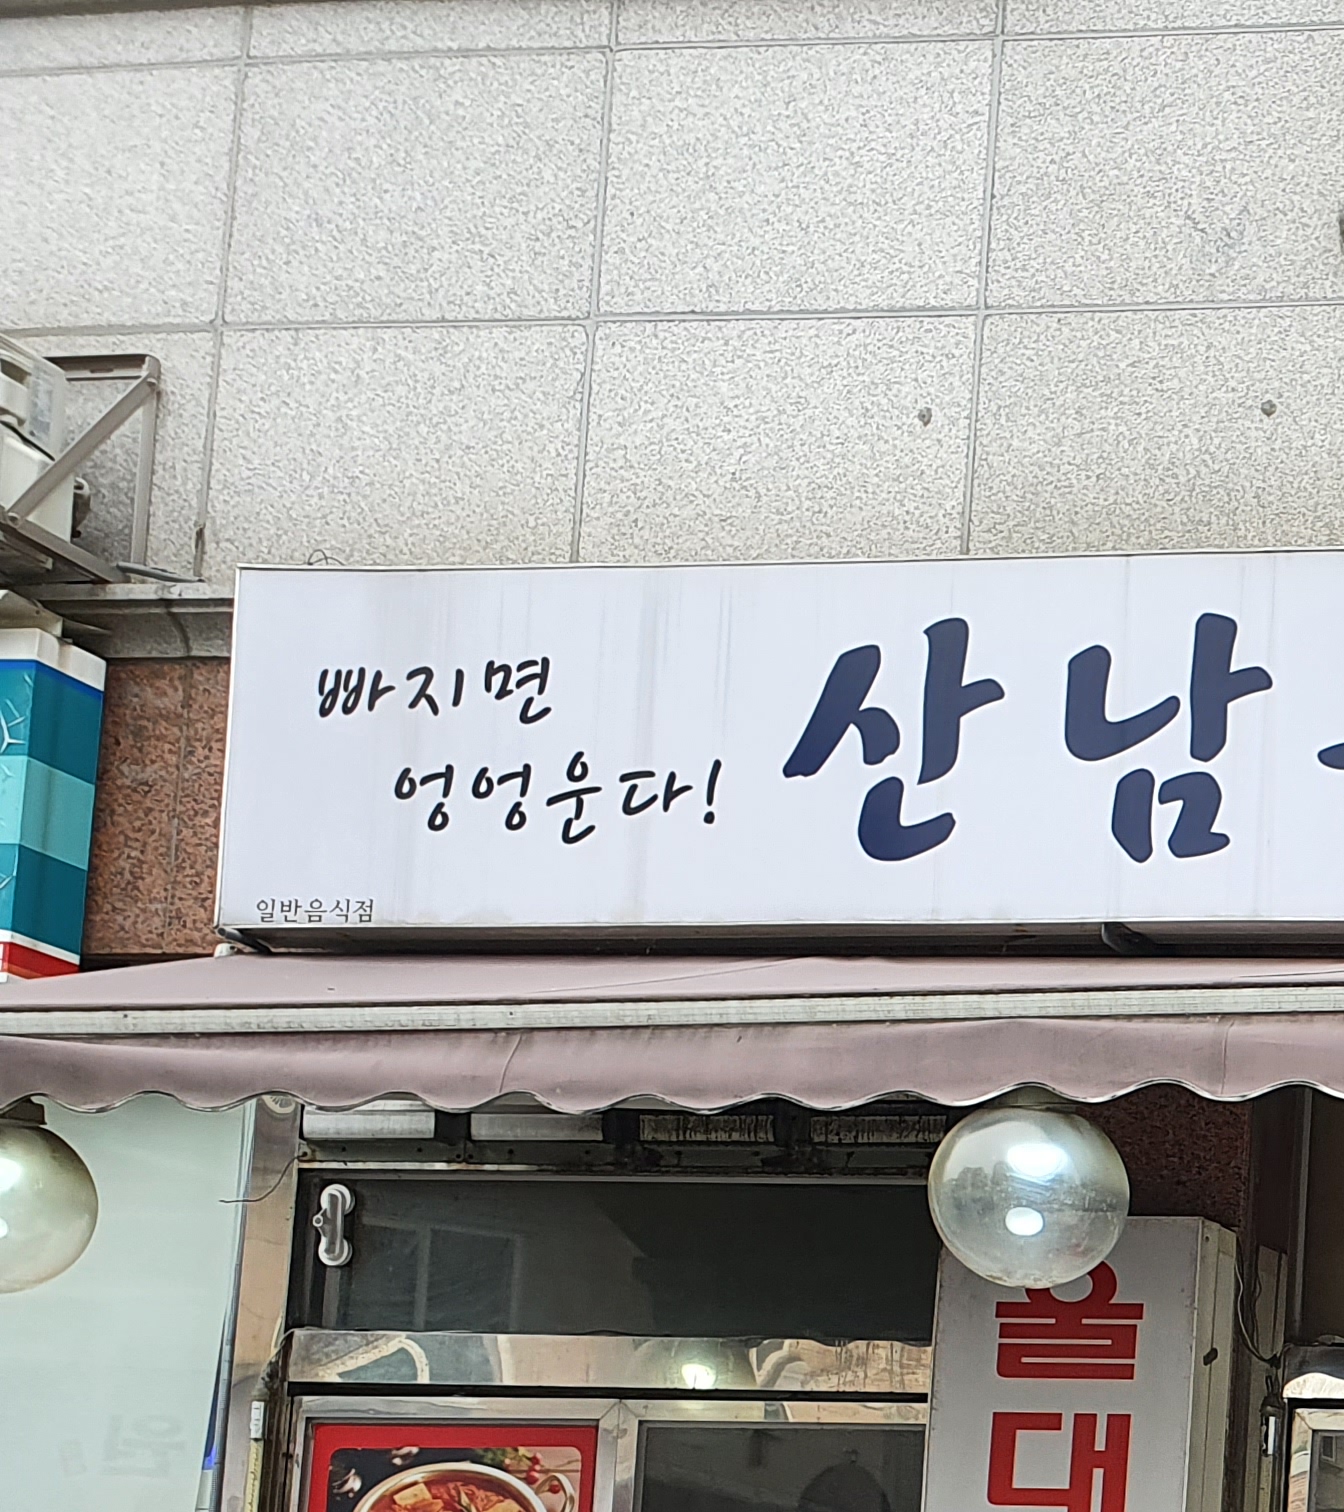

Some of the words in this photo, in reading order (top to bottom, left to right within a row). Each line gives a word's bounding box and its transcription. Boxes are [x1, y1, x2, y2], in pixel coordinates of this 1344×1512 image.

[316, 656, 555, 724] 빠지면
[393, 750, 725, 844] 엉엉운다!
[254, 896, 376, 925] 일반음식점
